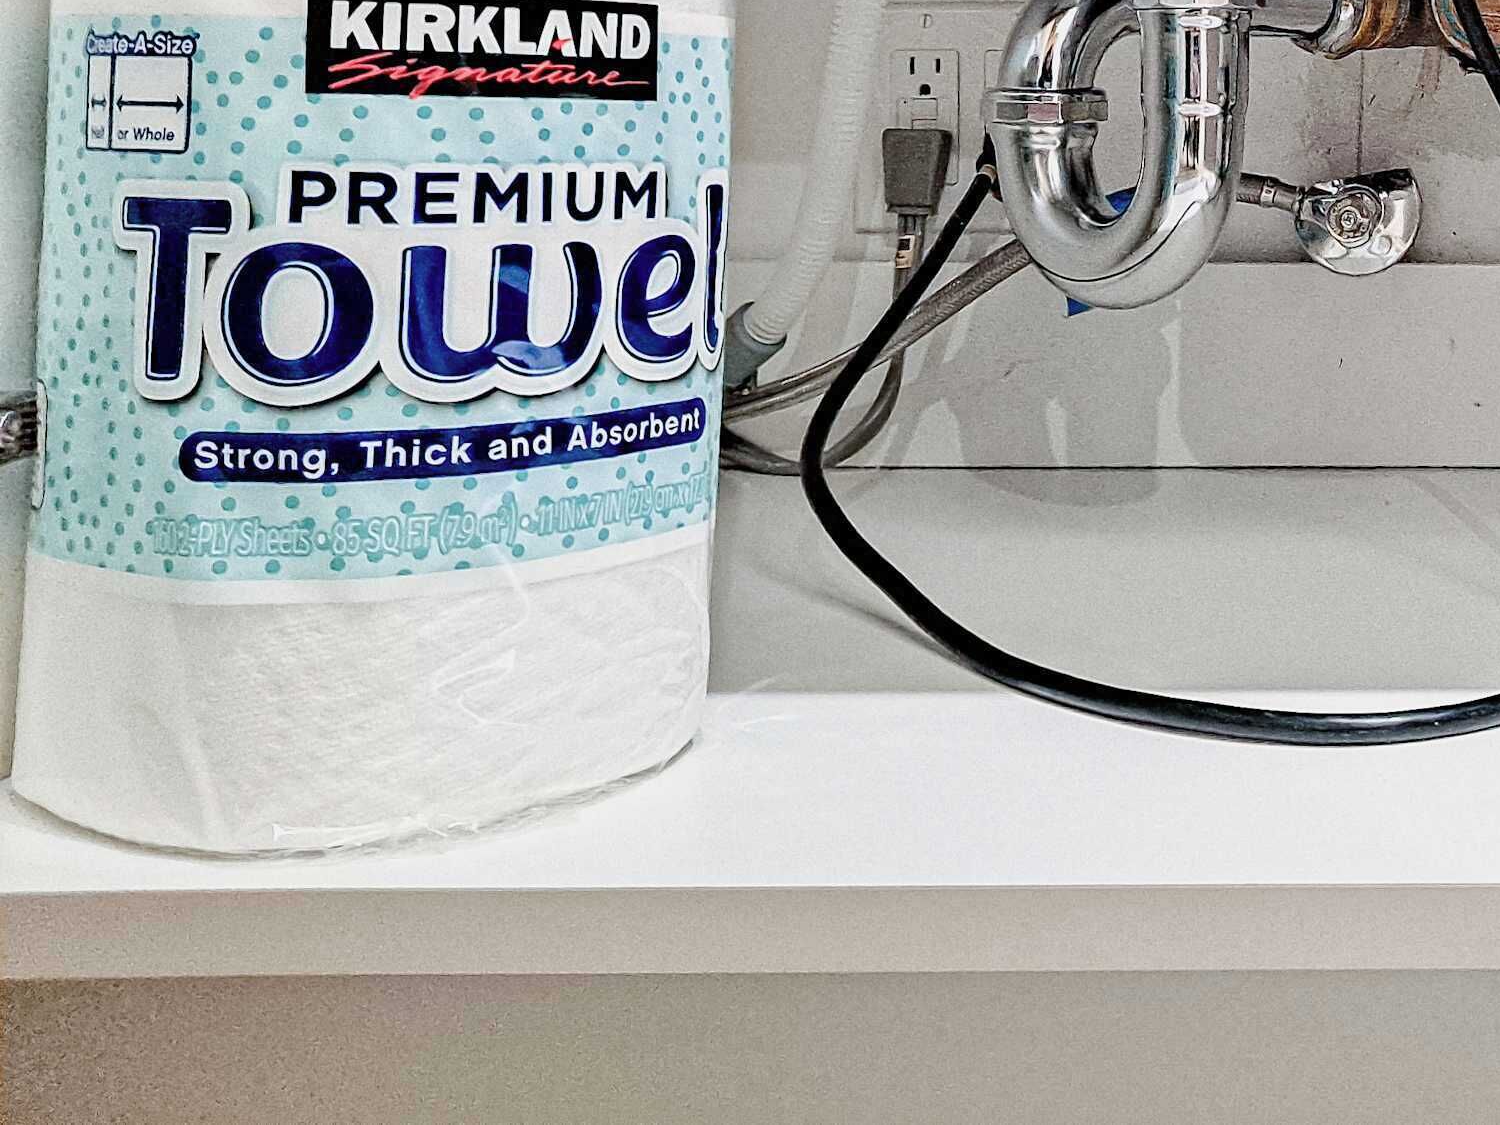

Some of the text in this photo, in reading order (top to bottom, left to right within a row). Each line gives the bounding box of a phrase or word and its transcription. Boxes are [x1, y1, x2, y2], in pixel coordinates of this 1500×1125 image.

[87, 33, 194, 54] Create-A-Size
[329, 0, 651, 60] KIRKLAND
[327, 51, 650, 99] Signature
[133, 127, 175, 141] Whole
[288, 170, 659, 225] PREMIUM
[121, 183, 726, 389] Towel
[194, 406, 701, 480] Strong, Thick and Absorbent
[236, 518, 312, 555] Sheets
[332, 520, 361, 555] 85
[366, 517, 400, 555] SQ
[407, 514, 435, 550] FT
